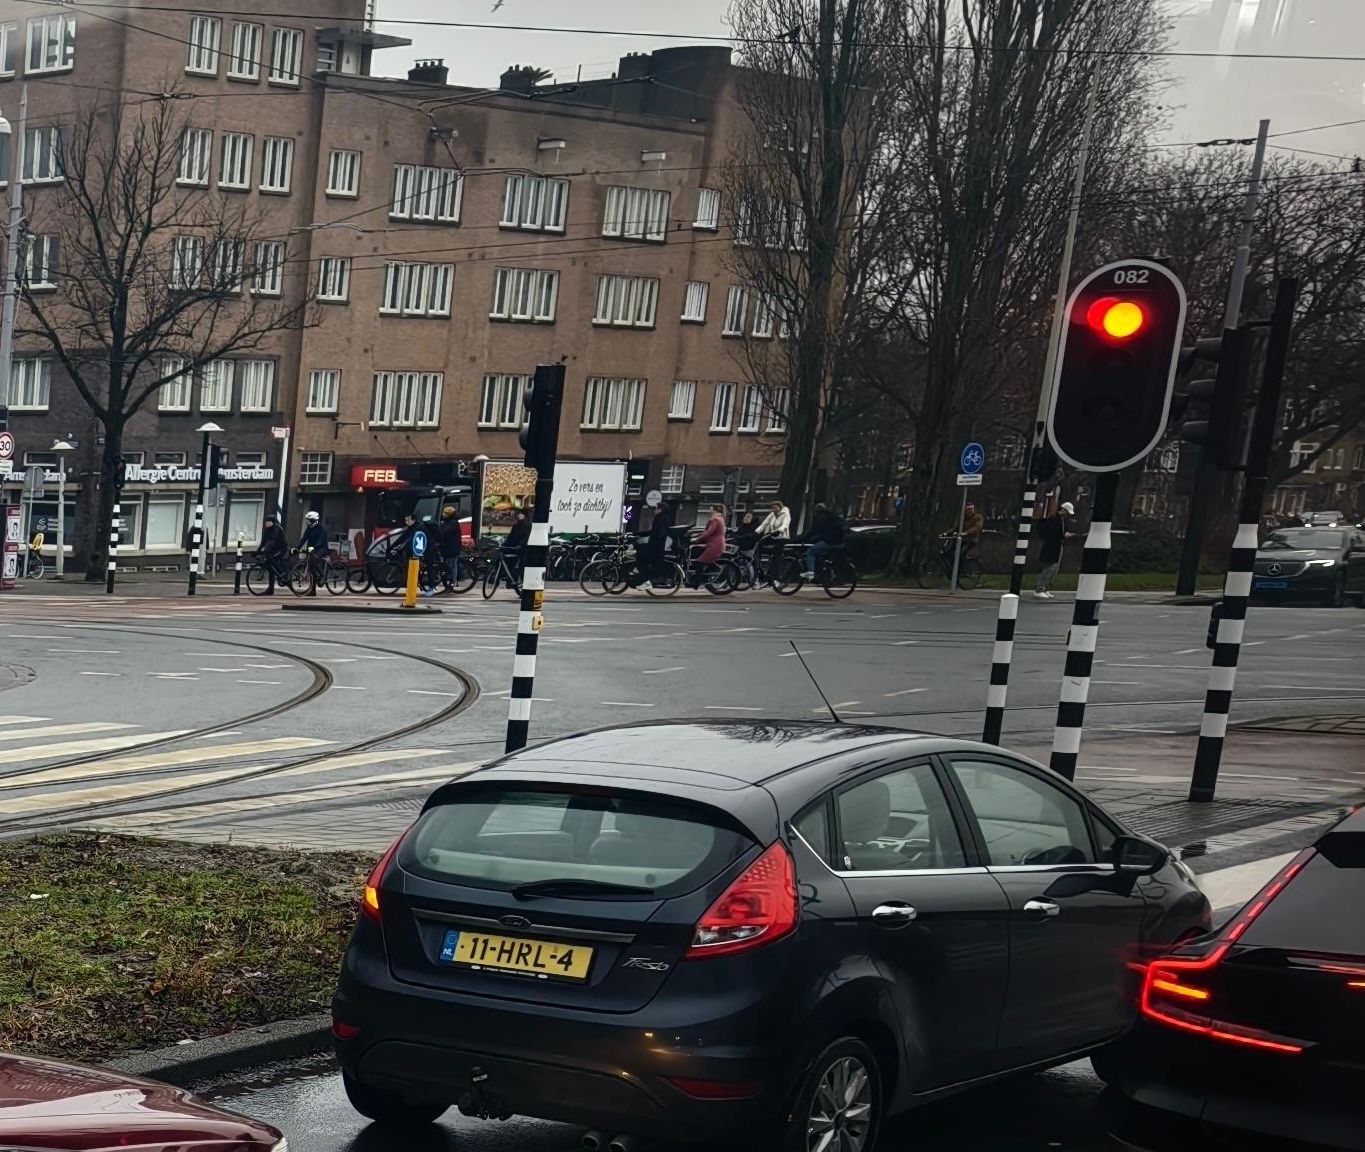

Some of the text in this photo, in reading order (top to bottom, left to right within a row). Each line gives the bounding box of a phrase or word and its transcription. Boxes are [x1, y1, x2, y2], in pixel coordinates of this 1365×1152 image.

[1114, 270, 1149, 285] 082
[0, 441, 11, 451] 30
[125, 464, 167, 483] Allergie
[169, 466, 201, 480] Centr
[364, 469, 405, 483] FEB
[569, 479, 604, 493] Zo vers en
[573, 502, 582, 517] zo
[469, 937, 574, 972] 11-HRL-4
